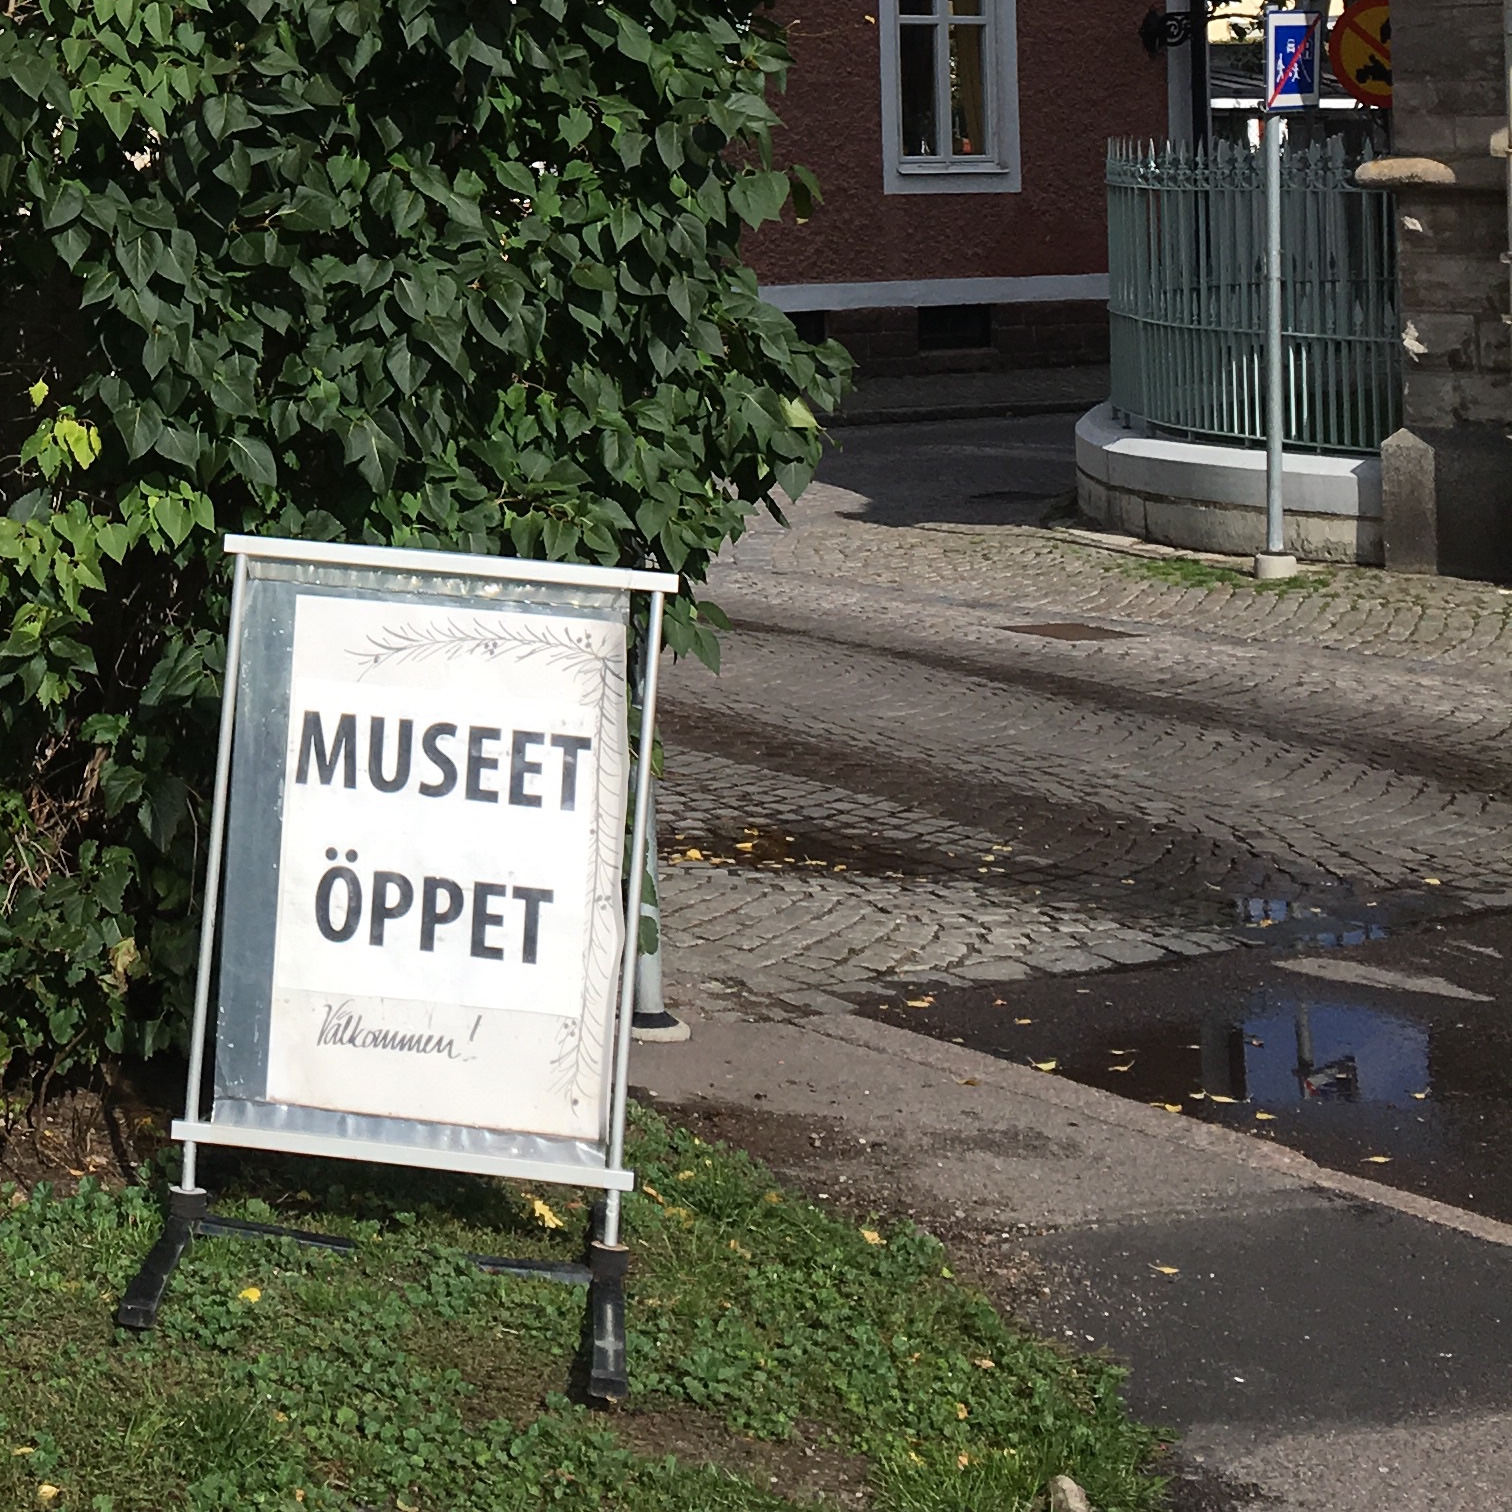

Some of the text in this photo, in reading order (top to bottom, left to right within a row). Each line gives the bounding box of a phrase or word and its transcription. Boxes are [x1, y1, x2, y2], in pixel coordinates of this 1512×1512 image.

[295, 709, 592, 811] MUSEET
[315, 847, 554, 965] ÖPPET
[316, 999, 482, 1061] Välkommen!
